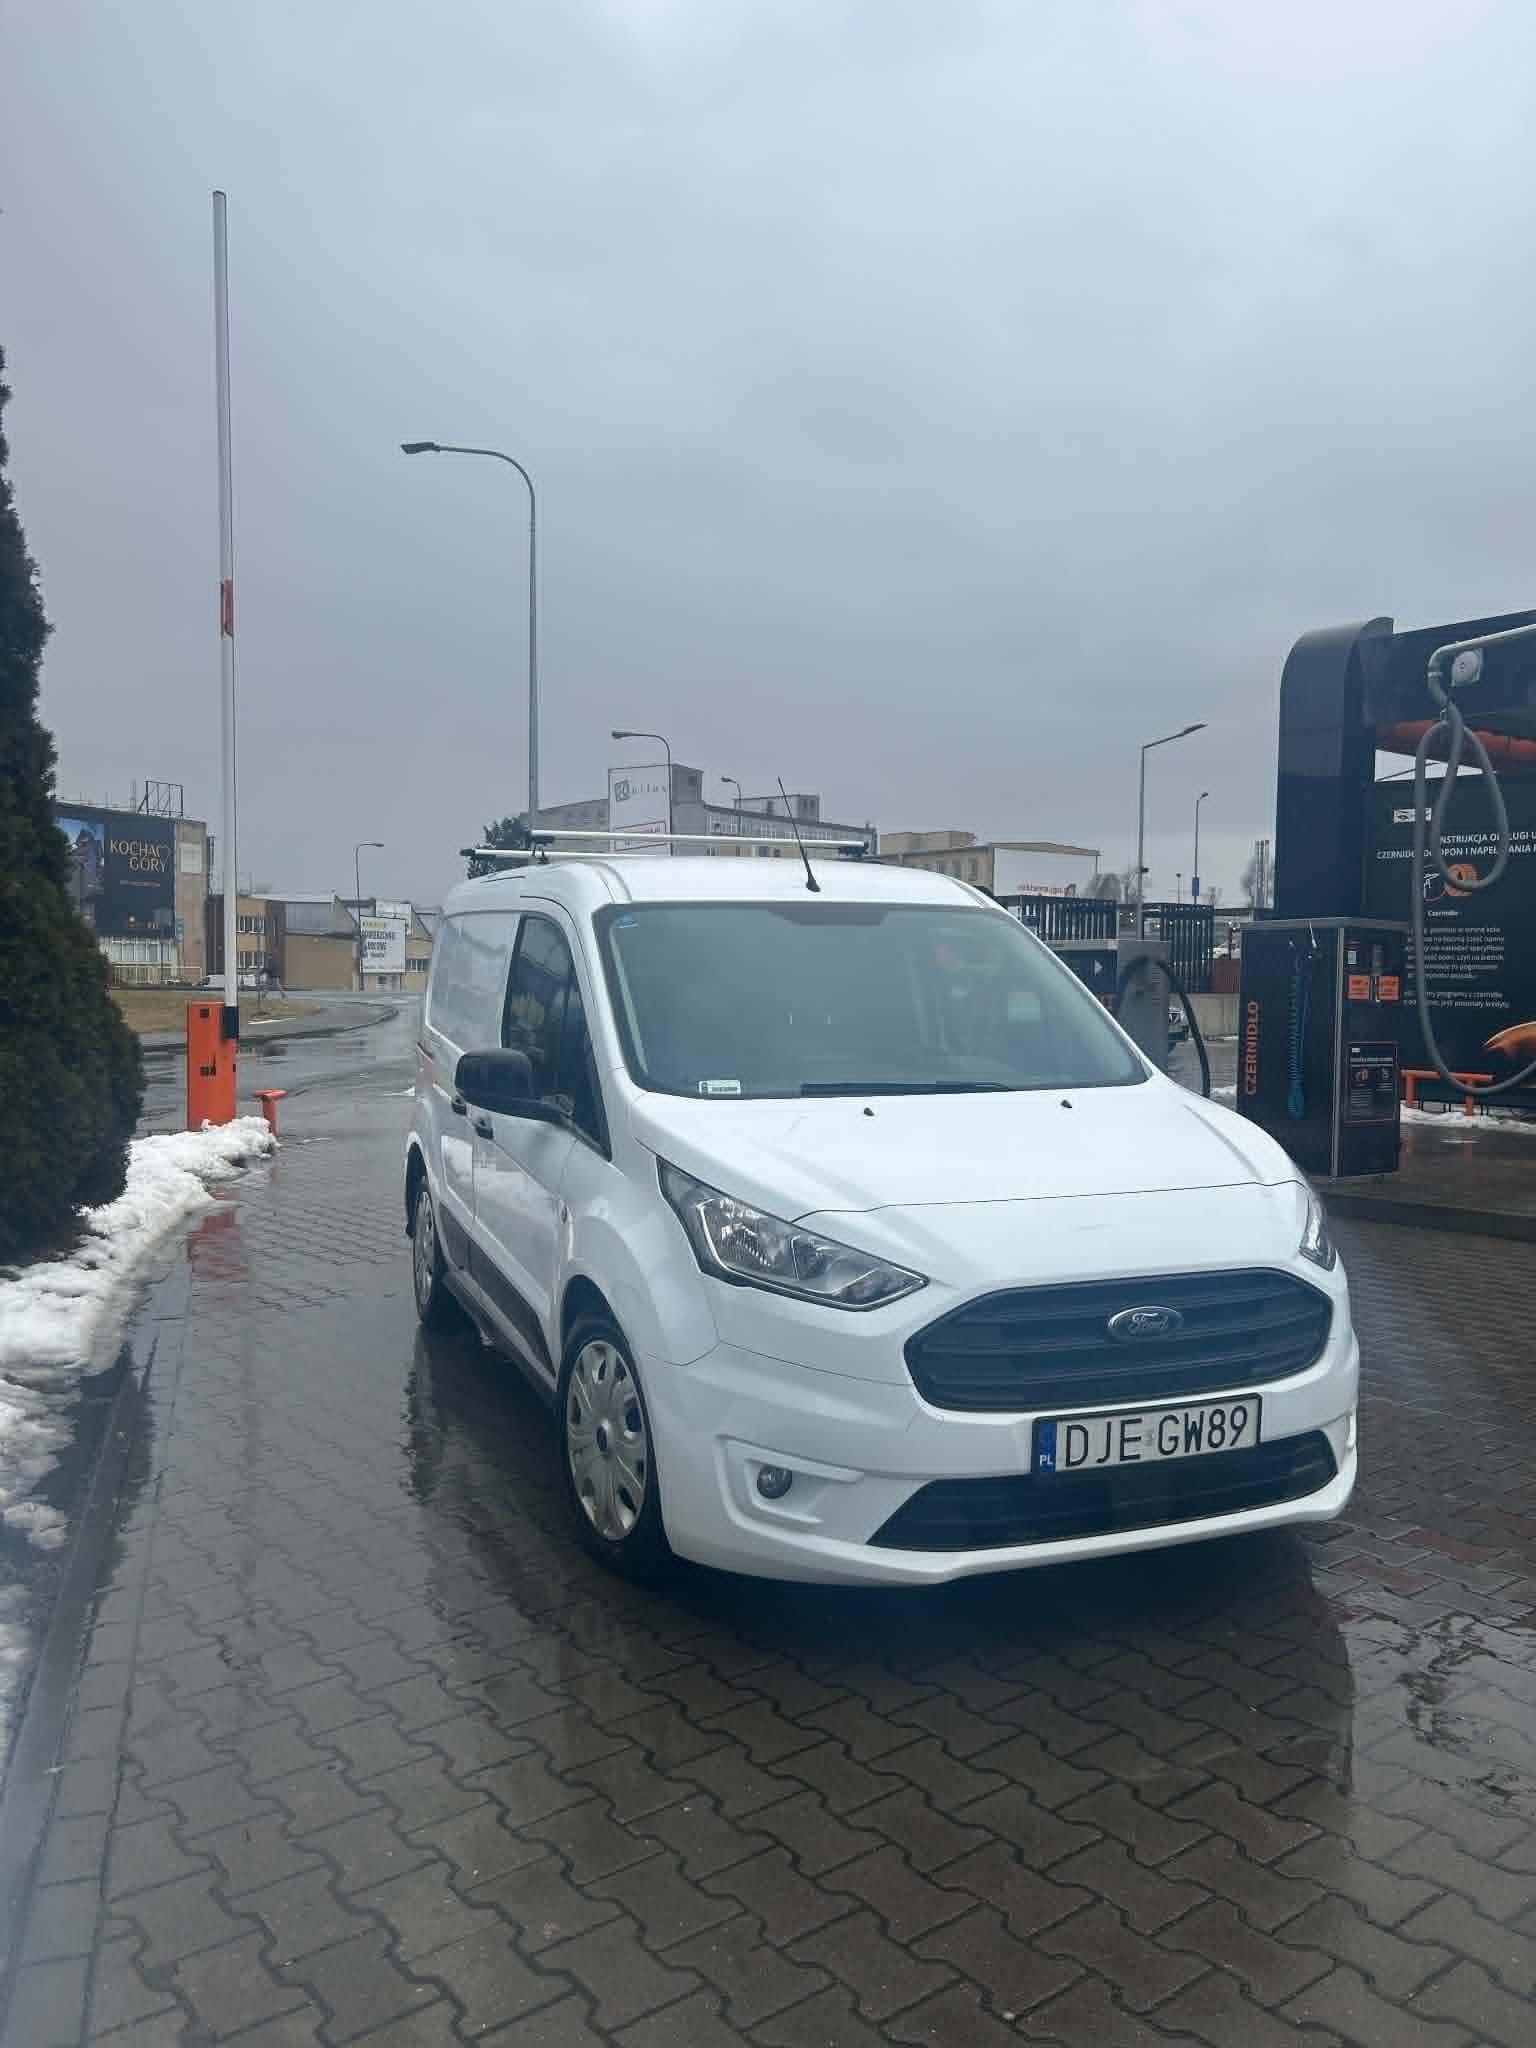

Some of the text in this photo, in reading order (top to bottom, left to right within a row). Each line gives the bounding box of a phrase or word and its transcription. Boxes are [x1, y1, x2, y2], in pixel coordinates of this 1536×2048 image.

[1440, 833, 1488, 845] NSTRUKCJA
[1065, 1405, 1248, 1468] DJE GW89
[1040, 1455, 1053, 1466] PL
